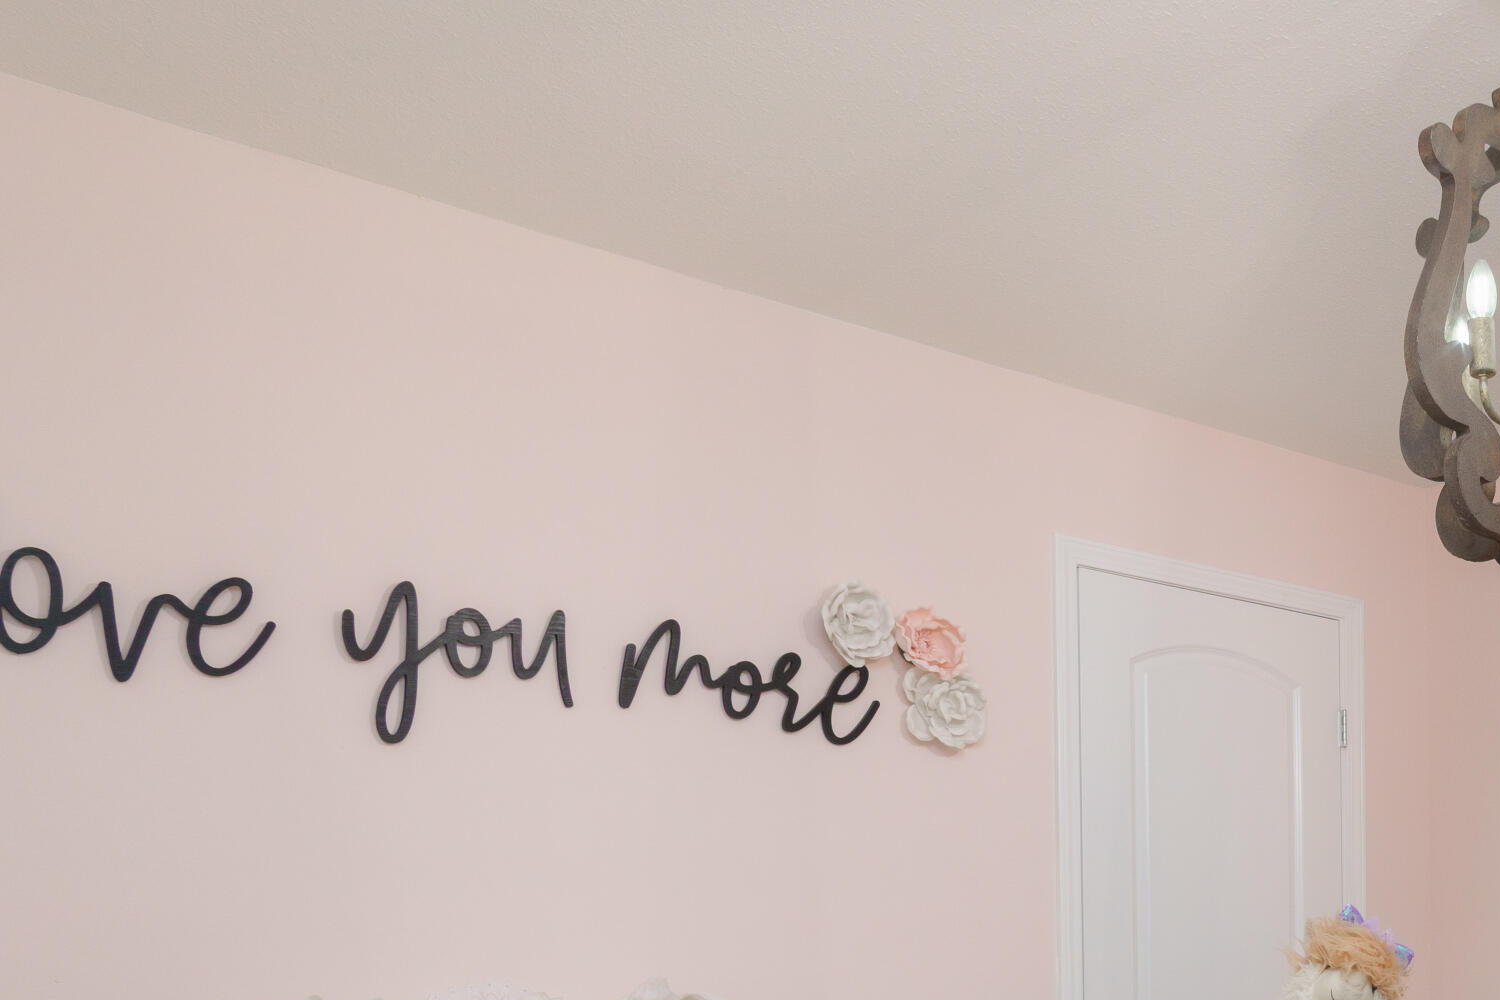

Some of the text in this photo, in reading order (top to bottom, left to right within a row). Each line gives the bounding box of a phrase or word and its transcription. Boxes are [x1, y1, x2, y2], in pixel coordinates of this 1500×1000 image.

[0, 547, 881, 746] ove you more
